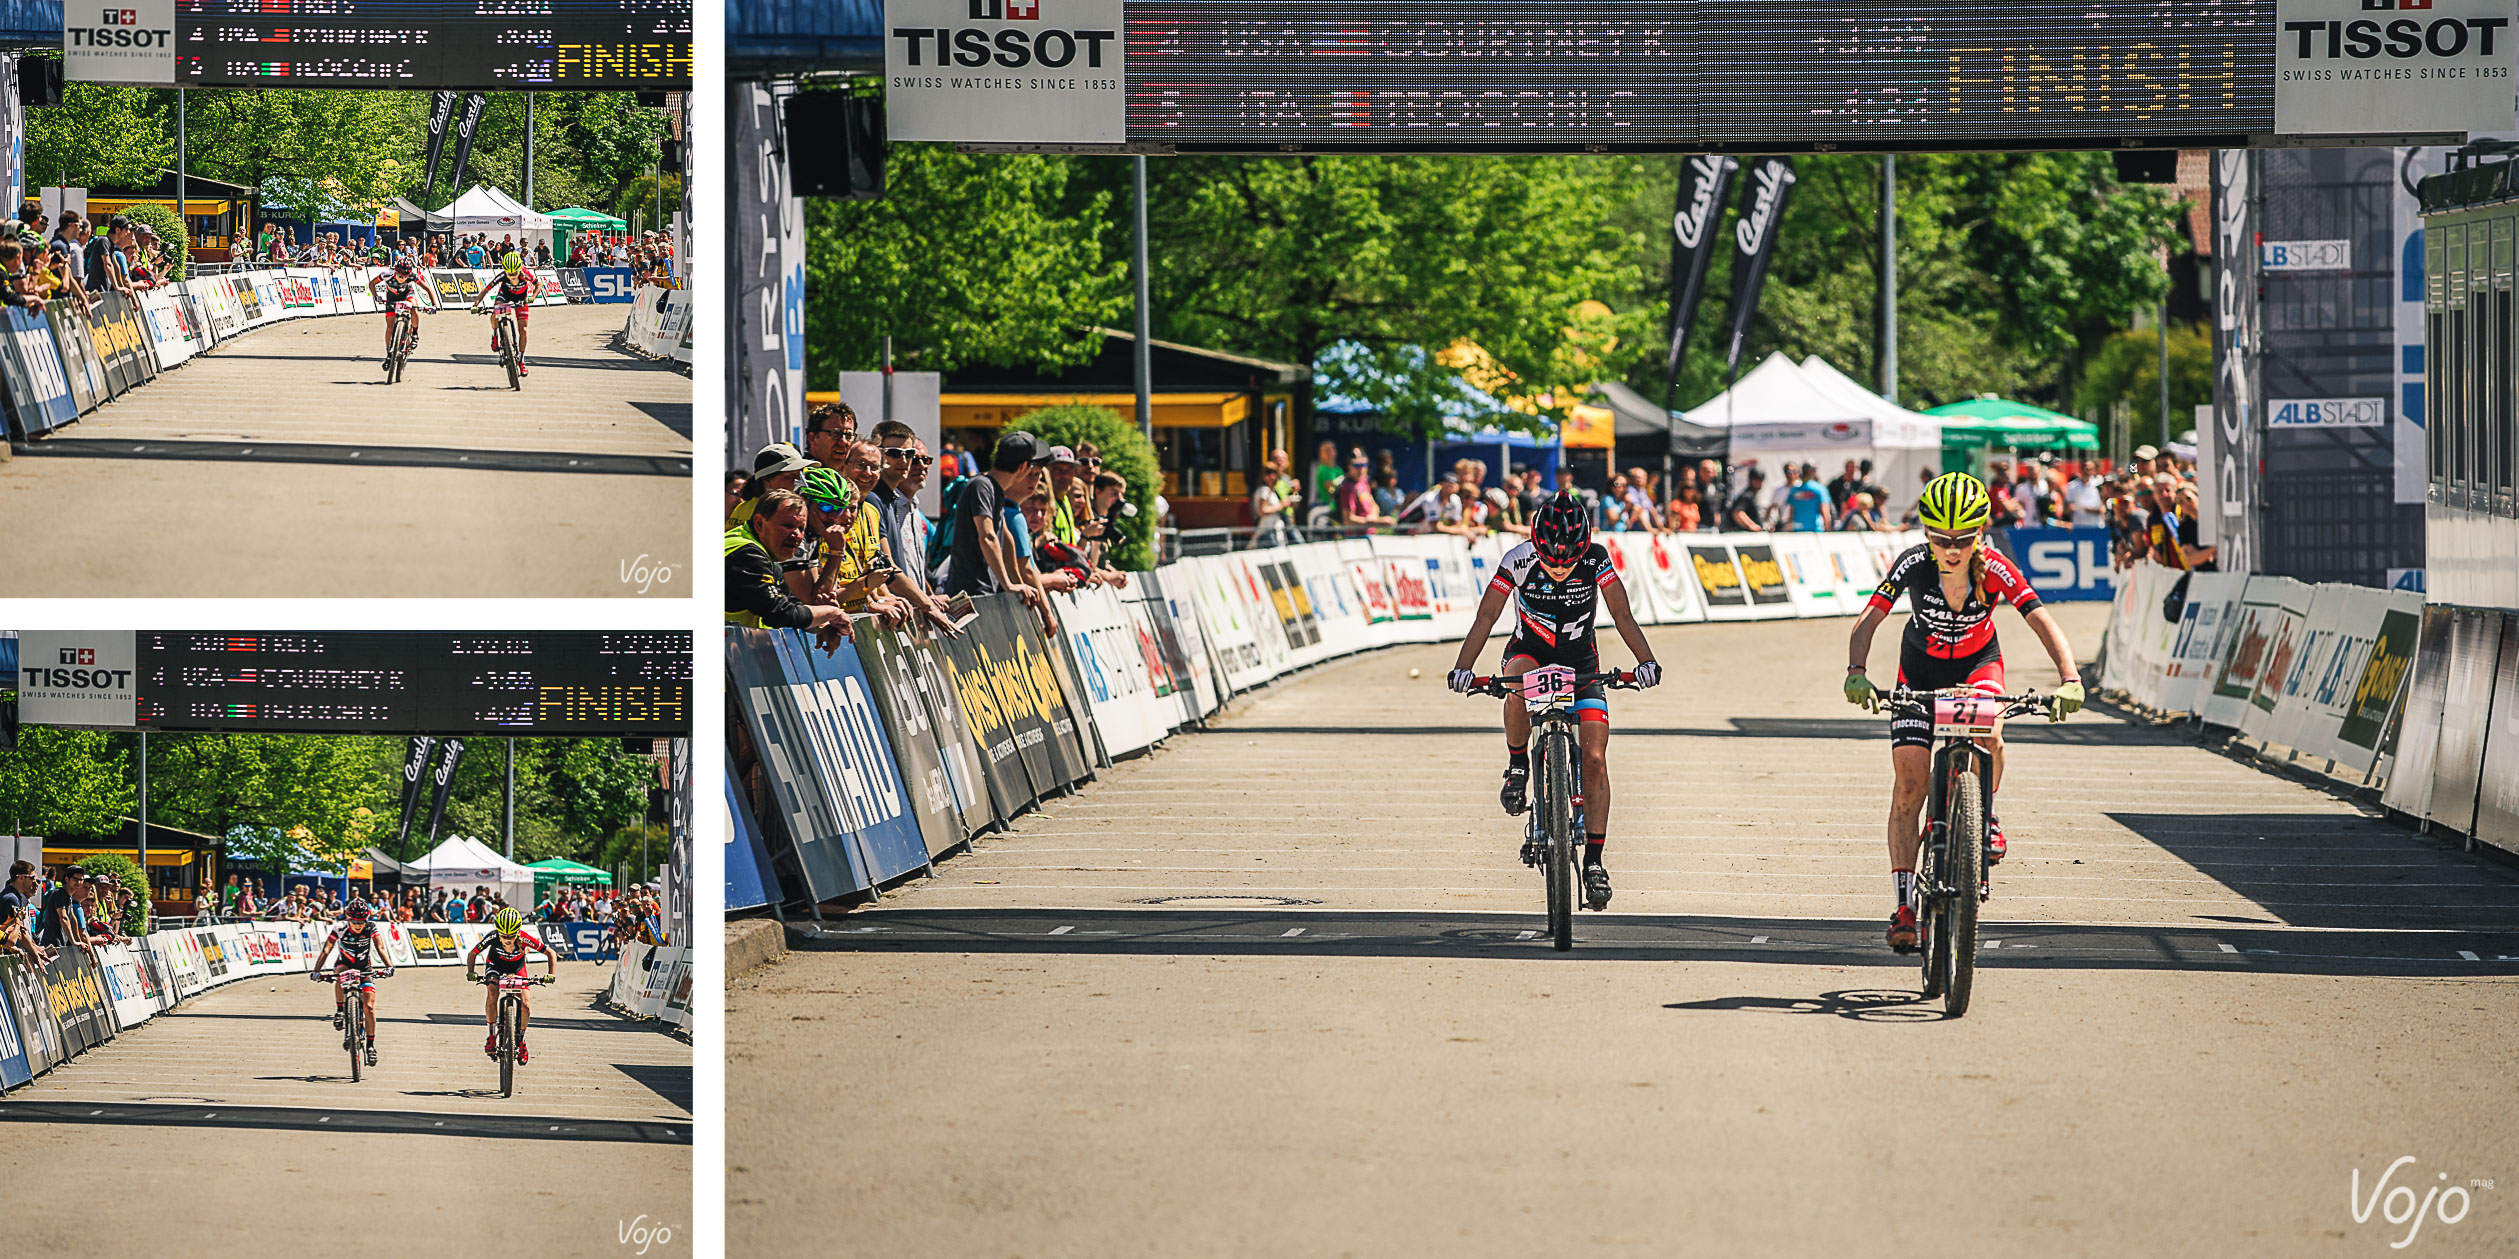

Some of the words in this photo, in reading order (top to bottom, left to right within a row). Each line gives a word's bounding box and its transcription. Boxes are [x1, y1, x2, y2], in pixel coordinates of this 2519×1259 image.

[67, 28, 171, 48] TISSOT
[892, 28, 1115, 68] TISSOT
[1221, 20, 1306, 56] USA
[1380, 20, 1627, 56] COURTNEY
[2284, 18, 2508, 60] TISSOT
[558, 44, 692, 78] FINISH
[2283, 70, 2333, 82] SWISS
[2341, 69, 2413, 81] WATCHES
[2421, 68, 2468, 79] SINCE
[2474, 67, 2508, 79] 1853
[893, 77, 942, 88] SWISS
[950, 78, 1022, 89] WATCHES
[1030, 79, 1076, 90] SINCE
[1084, 80, 1117, 90] 1853
[1948, 43, 2235, 120] FINISH
[1237, 91, 1308, 127] ITA
[1378, 91, 1590, 127] TEOCCHI
[2272, 401, 2383, 425] ALBSTADT
[22, 668, 132, 689] TISSOT
[1538, 672, 1562, 694] 36
[539, 686, 682, 722] FINISH
[1953, 702, 1978, 724] 27
